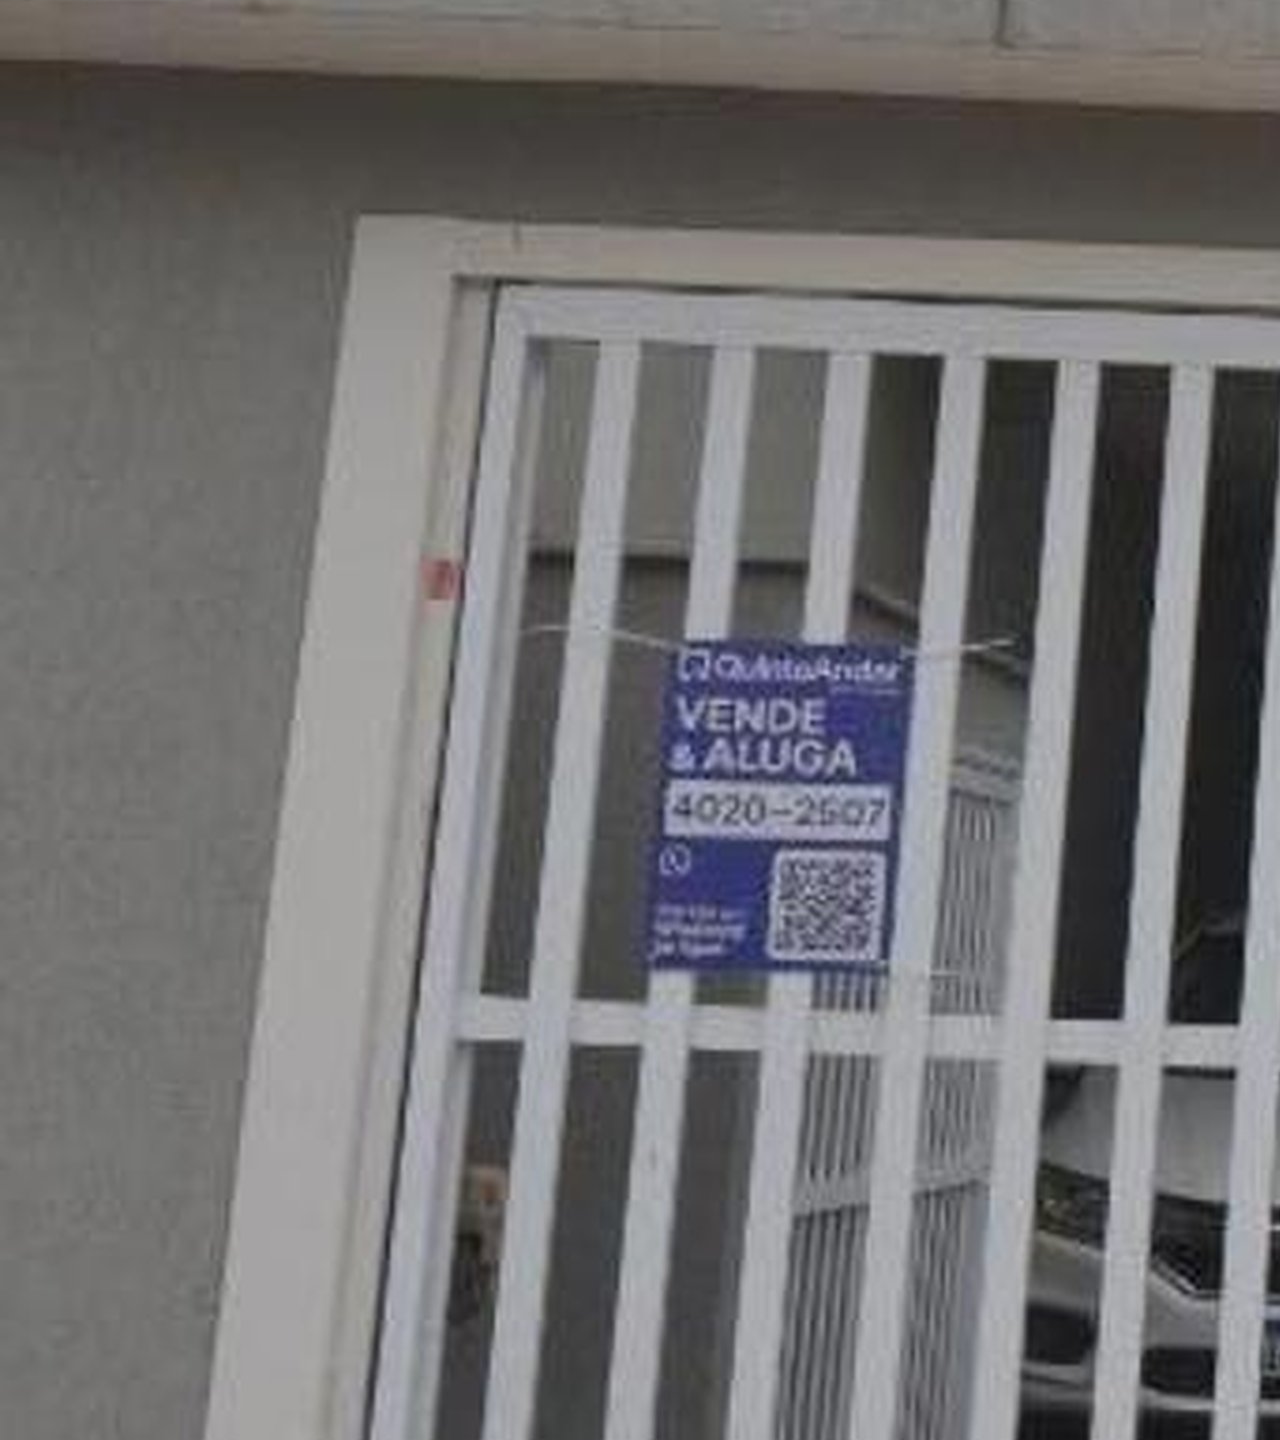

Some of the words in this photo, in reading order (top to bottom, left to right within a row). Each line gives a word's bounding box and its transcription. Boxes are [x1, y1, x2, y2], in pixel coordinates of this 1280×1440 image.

[676, 695, 828, 736] VENDE
[669, 742, 696, 772] &
[702, 736, 858, 778] ALUGA
